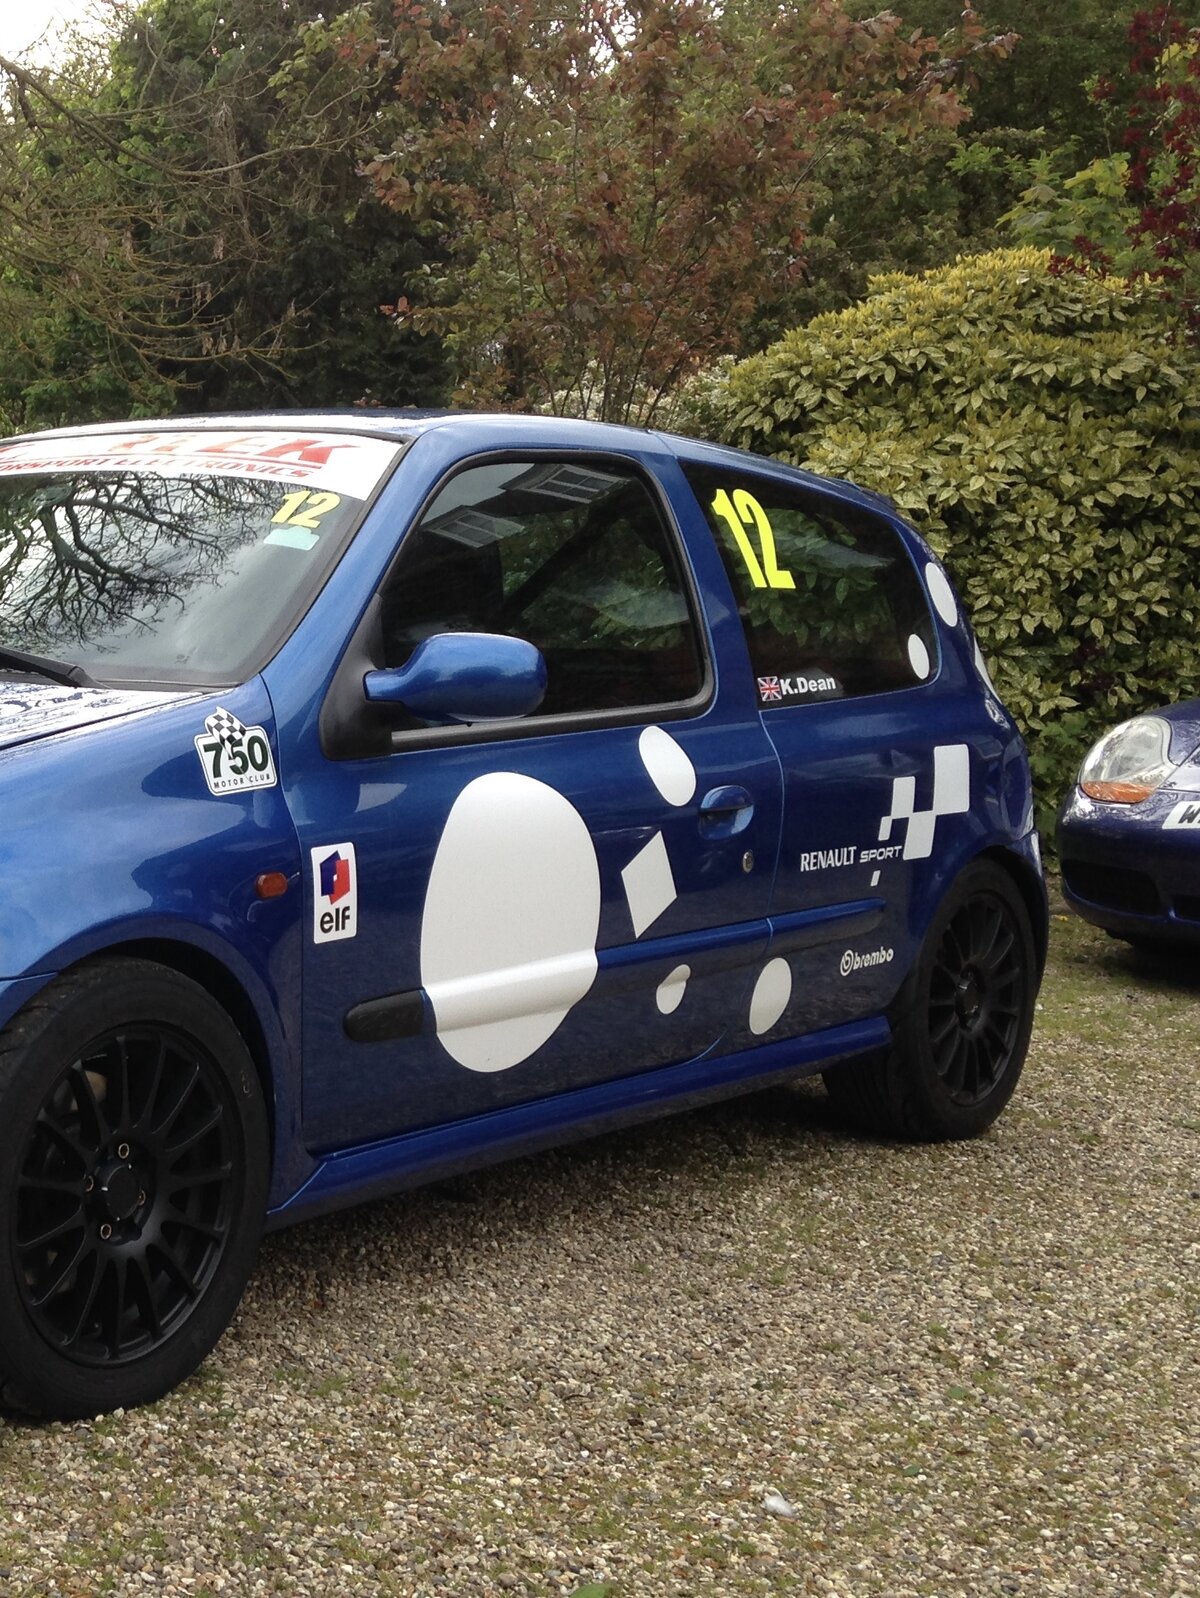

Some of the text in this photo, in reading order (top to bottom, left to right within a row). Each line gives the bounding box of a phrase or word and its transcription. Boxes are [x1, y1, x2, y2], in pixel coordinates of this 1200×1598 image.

[270, 490, 341, 529] 12
[711, 489, 796, 589] 12
[779, 676, 836, 695] K.Dean
[203, 735, 269, 779] 750
[213, 773, 270, 789] MOTOR CLUB
[800, 845, 902, 872] RENAULT SPORT
[320, 906, 351, 934] elf
[853, 946, 894, 970] brembo
